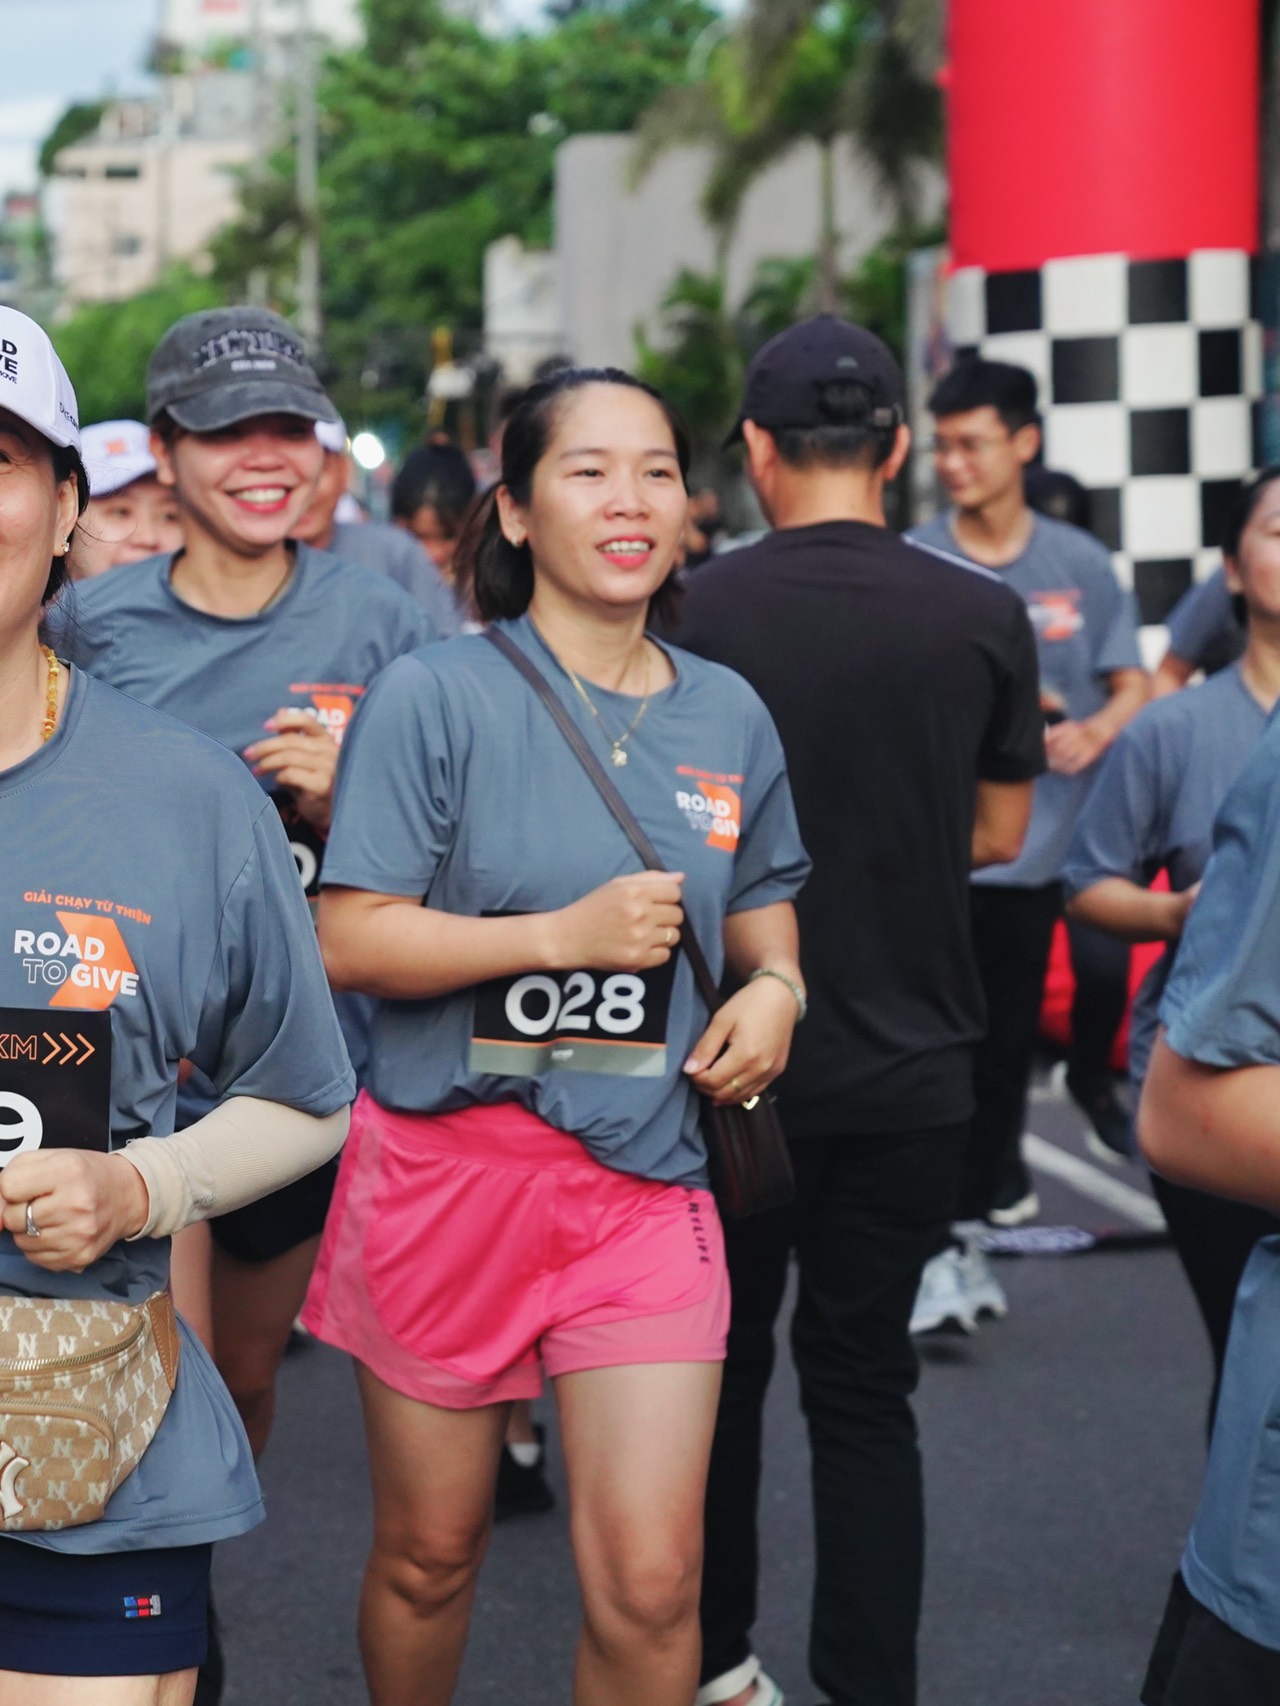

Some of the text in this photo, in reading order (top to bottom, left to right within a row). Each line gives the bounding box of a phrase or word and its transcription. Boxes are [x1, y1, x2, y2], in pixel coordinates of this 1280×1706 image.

[675, 791, 731, 818] ROAD
[24, 889, 152, 925] GIẢI CHẠY TỪ THIỆN
[14, 929, 105, 961] ROAD
[22, 958, 140, 997] TO GIVE
[505, 971, 646, 1036] 028
[34, 1309, 54, 1333] Y
[73, 1312, 92, 1338] Y
[91, 1301, 111, 1320] N
[16, 1333, 38, 1358] N
[133, 1350, 164, 1398] N N
[115, 1383, 159, 1428] N Y Y
[35, 1415, 52, 1436] Y
[75, 1419, 89, 1438] Y
[119, 1416, 157, 1464] N N
[52, 1437, 73, 1457] N
[31, 1457, 90, 1481] Y Y
[47, 1480, 110, 1504] N N
[27, 1498, 84, 1520] Y Y
